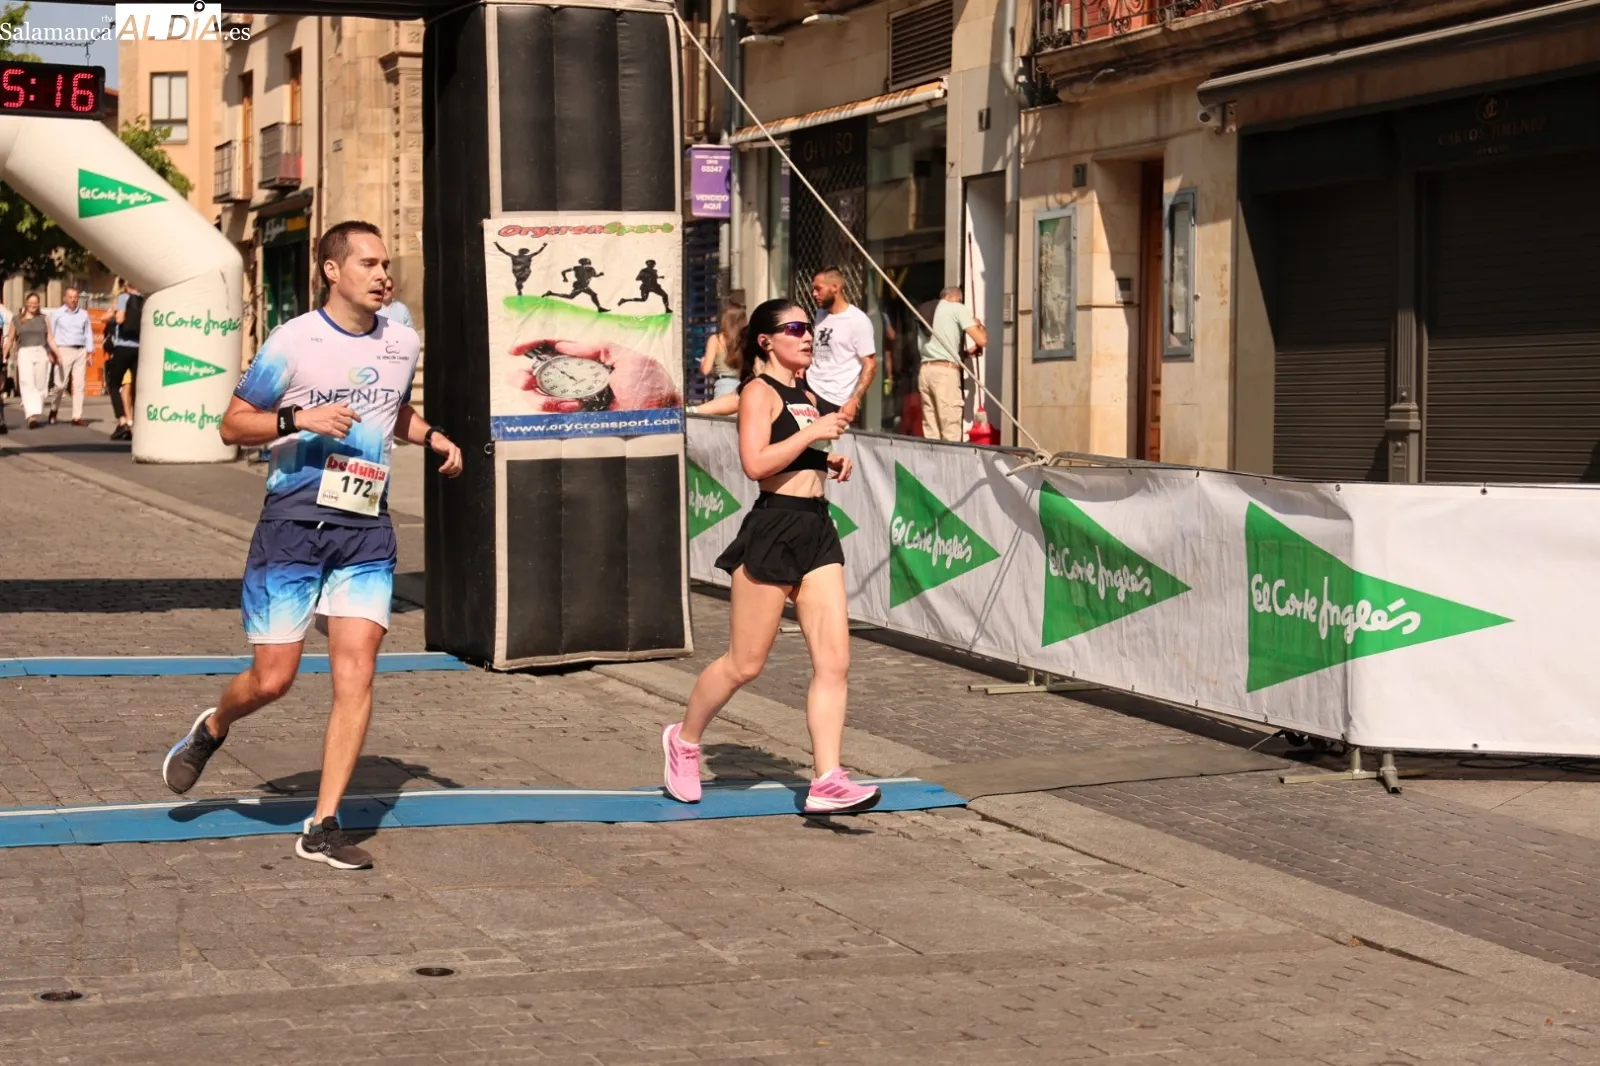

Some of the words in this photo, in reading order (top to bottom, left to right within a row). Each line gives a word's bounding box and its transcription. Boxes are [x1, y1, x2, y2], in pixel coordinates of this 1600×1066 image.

[2, 68, 95, 112] 5:16
[79, 186, 91, 199] El
[91, 188, 117, 200] Corte
[695, 194, 729, 202] VENDIDO
[153, 309, 165, 327] El
[165, 311, 202, 329] Corte
[309, 388, 405, 405] INFINITY
[146, 404, 158, 421] El
[159, 405, 197, 423] Corte
[505, 417, 680, 434] www.orycronsport.com
[327, 455, 386, 482] bedunia
[341, 475, 374, 499] 172
[891, 516, 905, 546] El
[905, 519, 933, 553] Corte
[931, 517, 973, 569] Inglés
[1048, 543, 1064, 577] El
[1063, 547, 1097, 584] Corte
[1095, 546, 1151, 603] Inglés
[1251, 573, 1272, 613] El
[1272, 578, 1317, 623] Corte
[1318, 576, 1421, 645] Inglés
